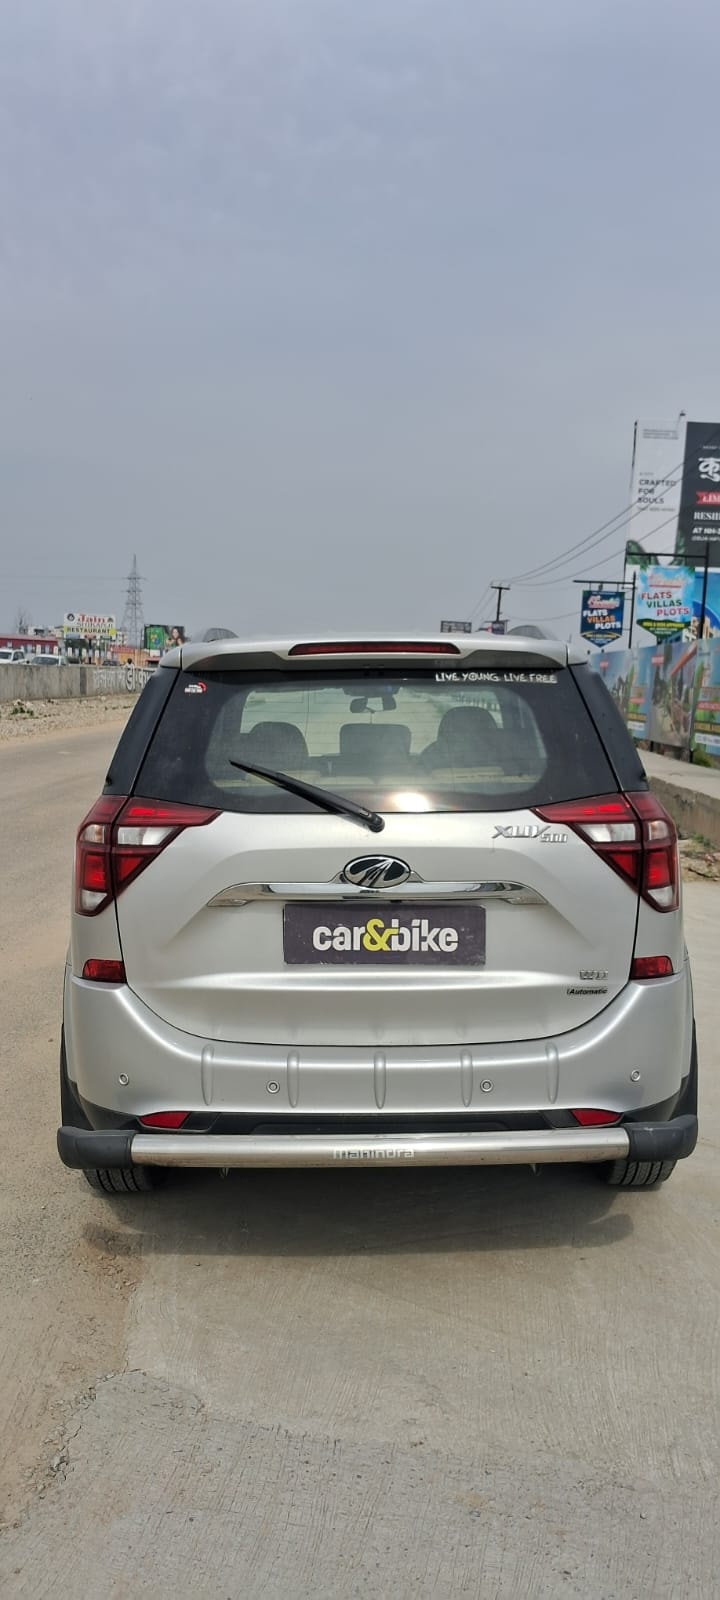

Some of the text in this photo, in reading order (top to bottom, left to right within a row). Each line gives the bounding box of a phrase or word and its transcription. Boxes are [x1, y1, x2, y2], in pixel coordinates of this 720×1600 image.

[641, 591, 672, 600] FLATS
[646, 600, 682, 609] VILLAS
[583, 609, 608, 617] FLATS
[656, 607, 689, 616] PLOTS
[586, 615, 616, 623] VILLAS
[595, 622, 621, 630] PLOTS
[434, 672, 558, 684] LIVE YOUNG LIVE FREE
[312, 918, 459, 953] car&bike
